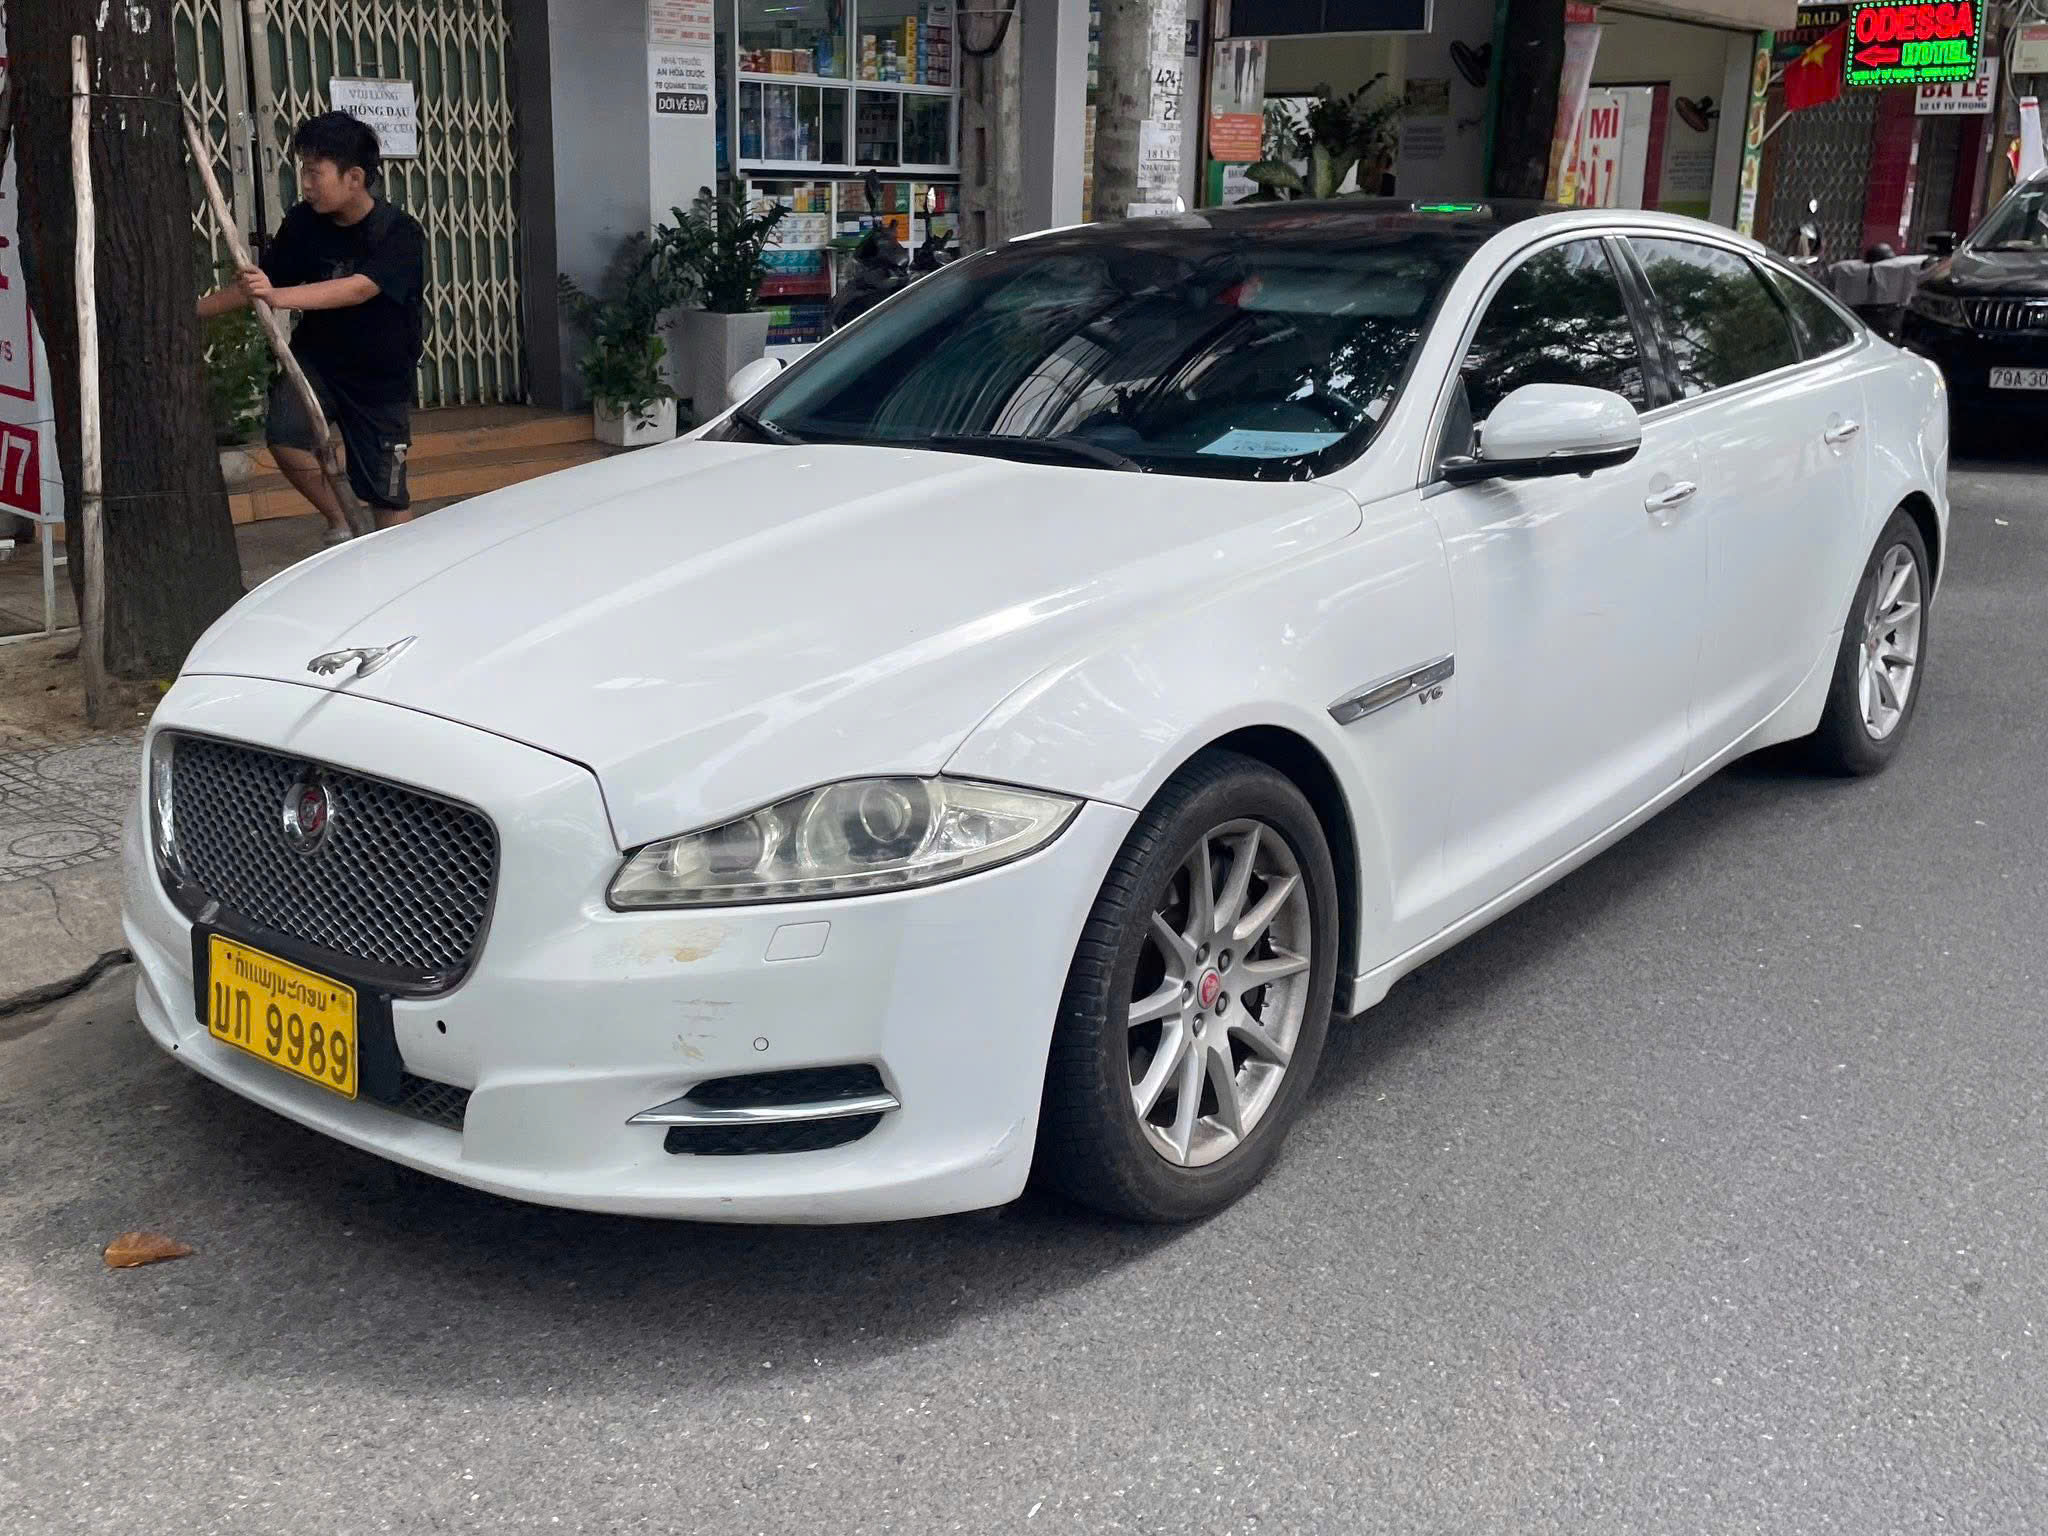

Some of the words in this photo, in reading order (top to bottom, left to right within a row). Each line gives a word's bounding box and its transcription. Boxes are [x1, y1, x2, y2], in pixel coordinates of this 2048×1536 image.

[1856, 3, 1974, 42] ODESSA
[1902, 40, 1971, 66] HOTEL
[656, 68, 668, 77] AN
[1588, 99, 1619, 139] MÌ
[1418, 685, 1444, 705] V6
[265, 1002, 348, 1085] 9989
